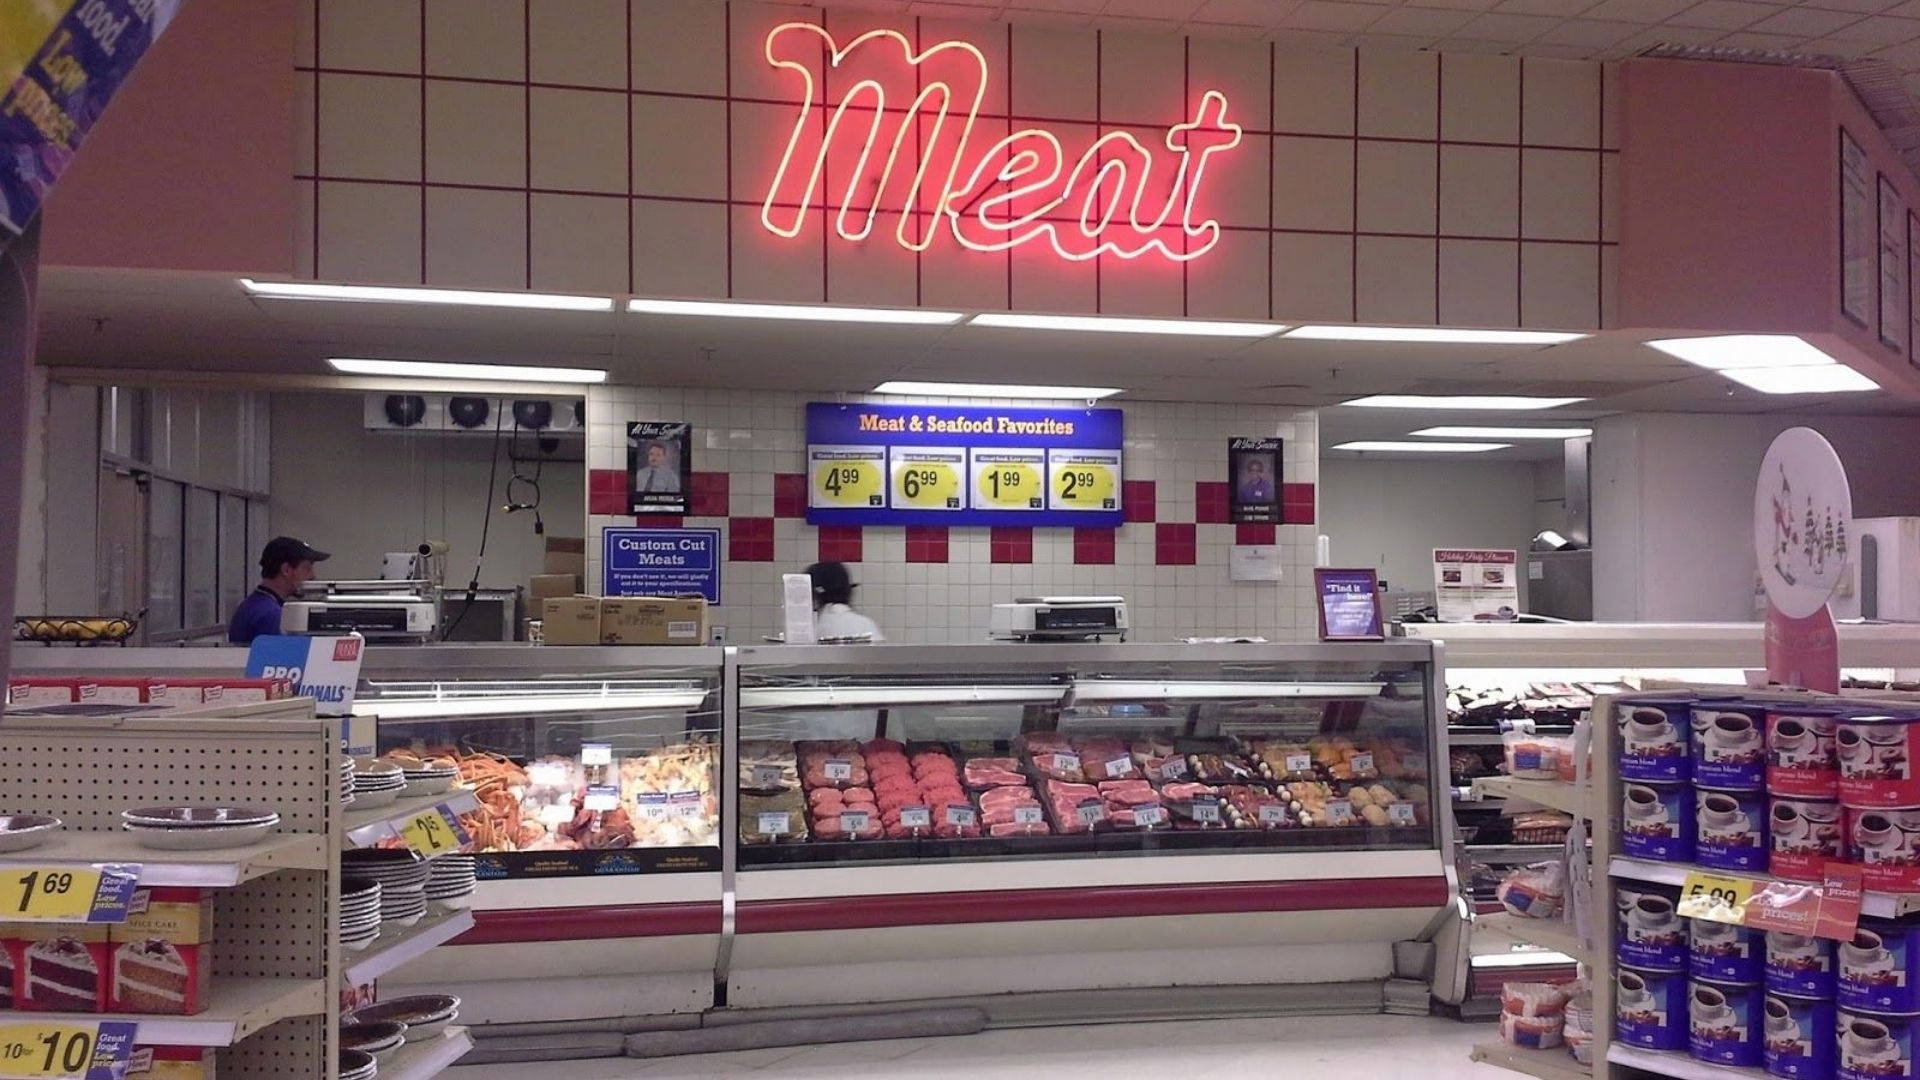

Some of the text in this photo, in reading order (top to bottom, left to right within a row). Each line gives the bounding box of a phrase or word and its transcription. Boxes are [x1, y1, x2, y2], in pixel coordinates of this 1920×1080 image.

[762, 22, 1242, 261] Meat
[858, 413, 1074, 435] Meat & Seafood Favorites
[618, 538, 706, 551] Custom Cut
[639, 553, 685, 565] Meats
[262, 666, 302, 685] PRO
[1824, 877, 1844, 888] Low
[99, 885, 122, 893] food.
[1762, 907, 1809, 922] prices!
[99, 1033, 127, 1042] Great
[96, 1042, 120, 1051] food.
